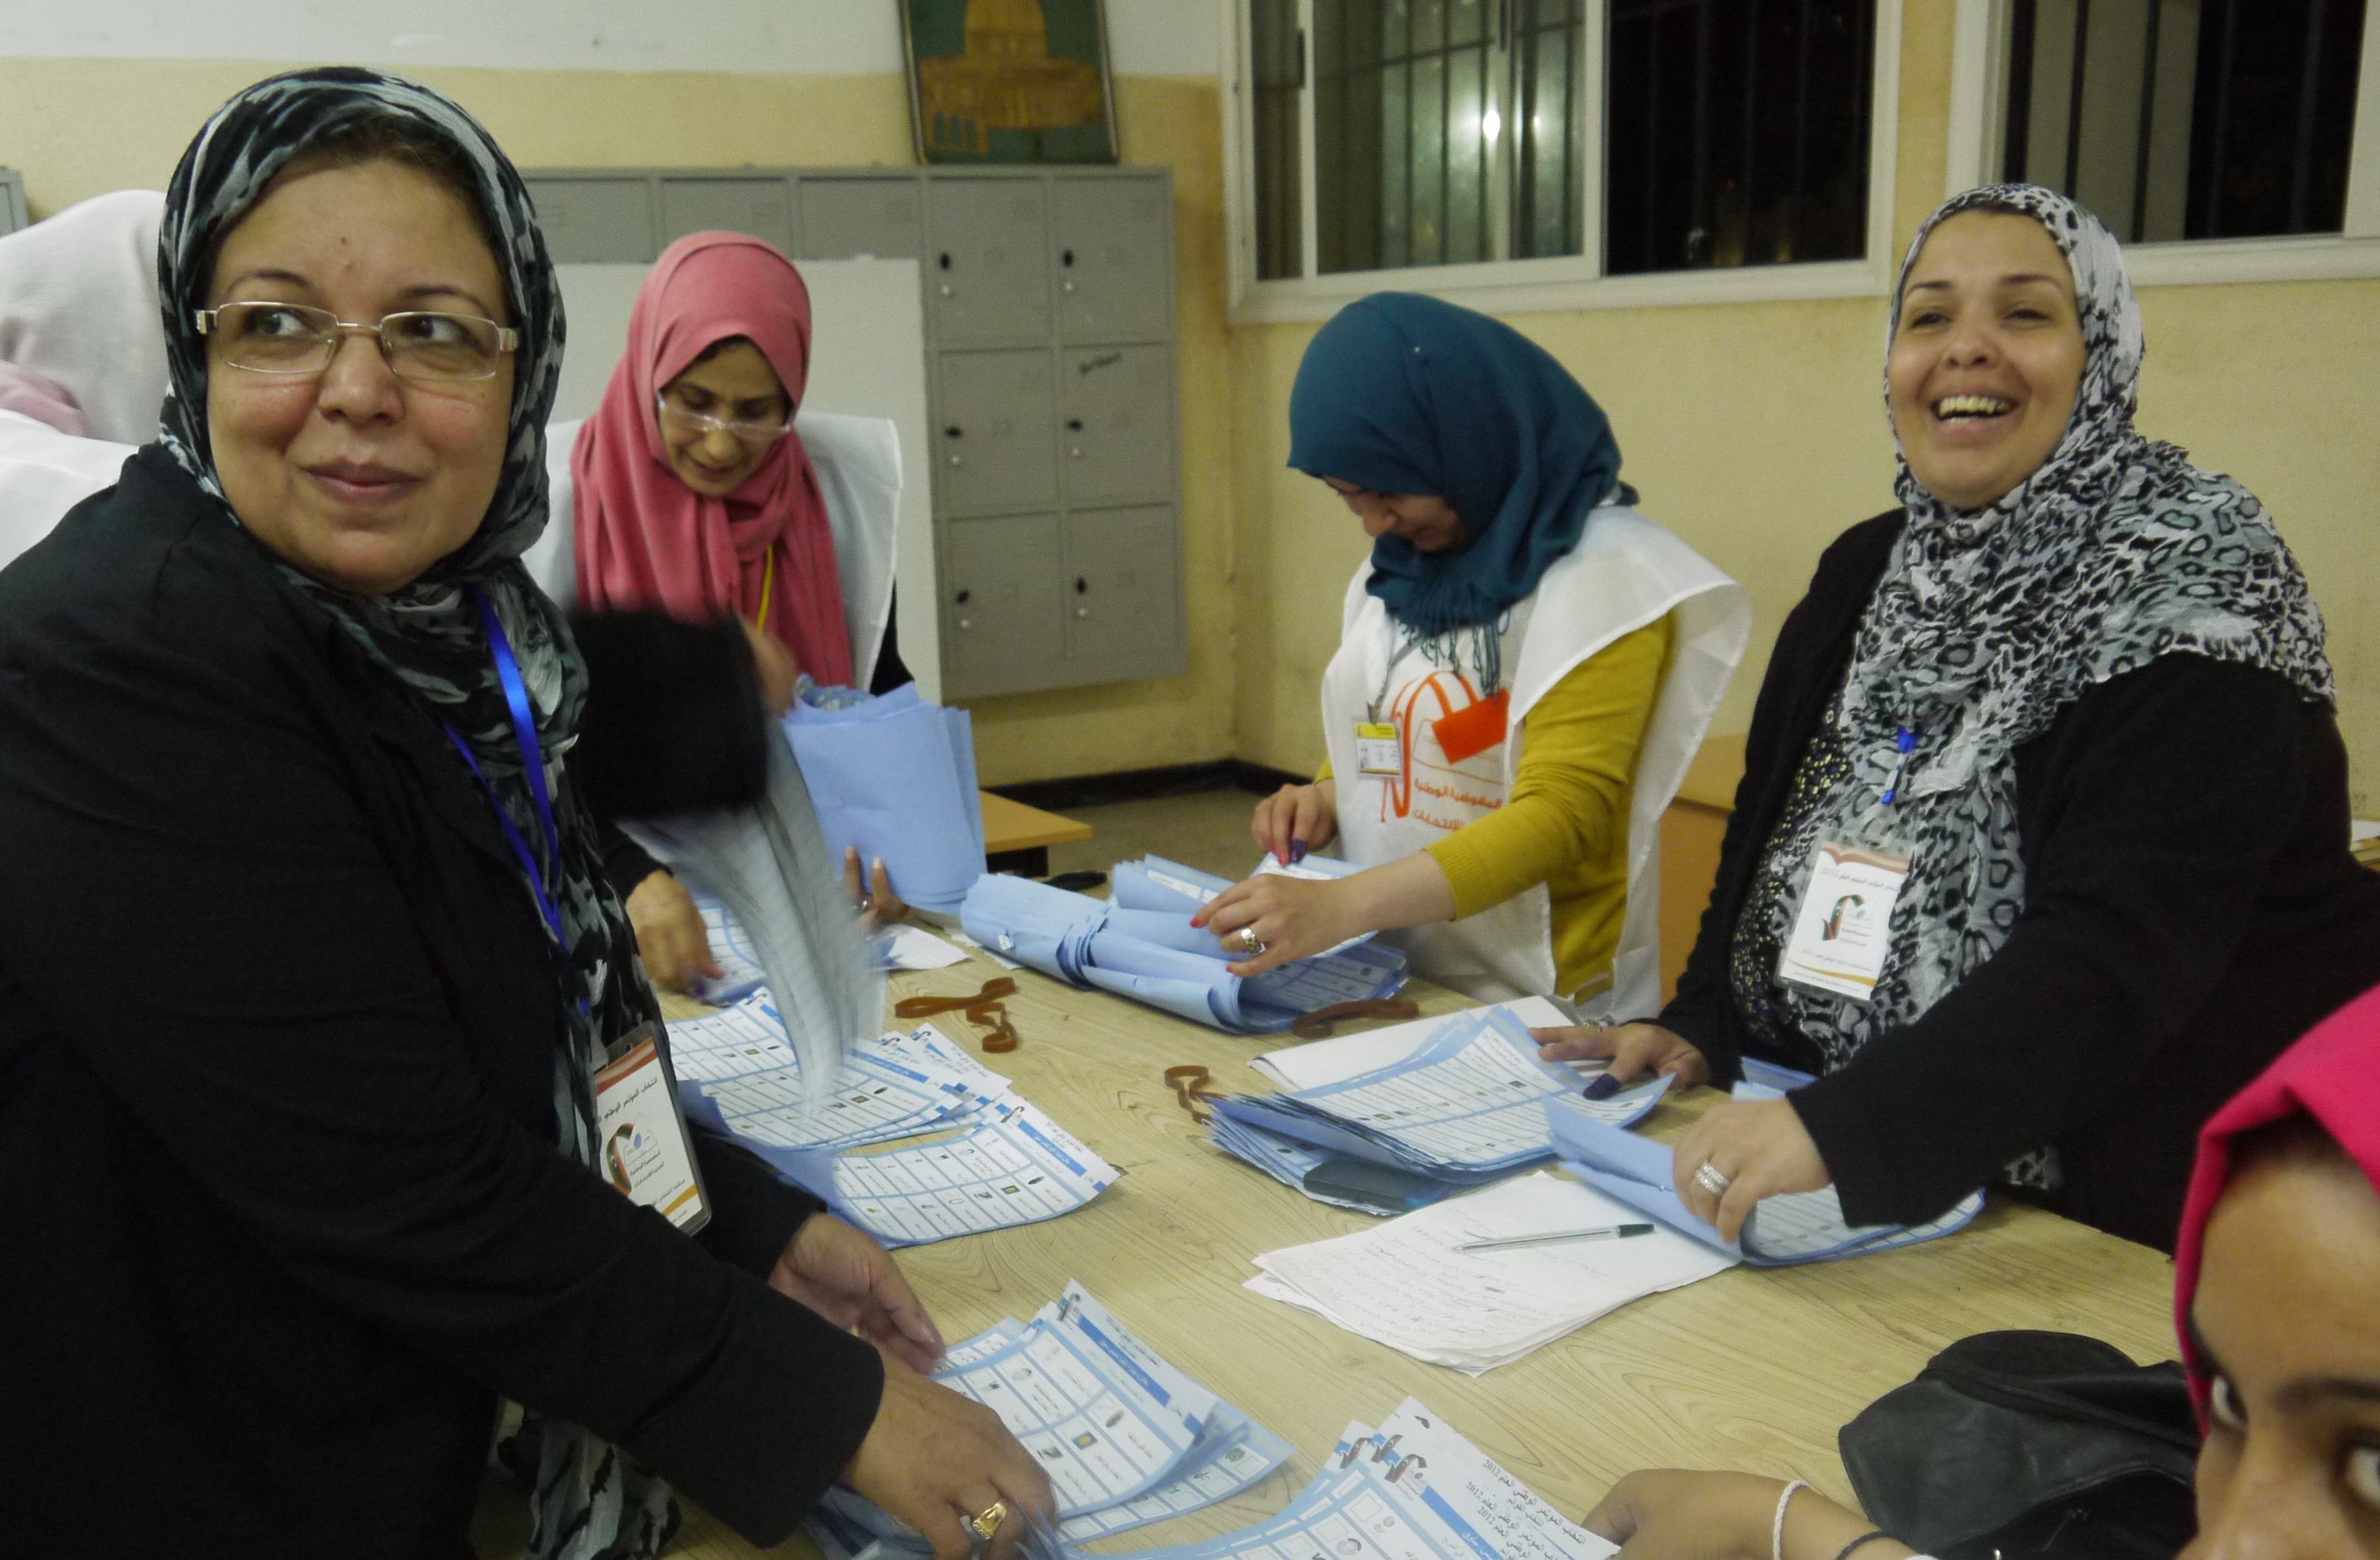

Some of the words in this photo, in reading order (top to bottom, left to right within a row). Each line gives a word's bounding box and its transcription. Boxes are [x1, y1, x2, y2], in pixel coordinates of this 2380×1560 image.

[1483, 1459, 1501, 1478] 2012
[1465, 1481, 1485, 1500] 2012
[1477, 1506, 1496, 1525] 2012
